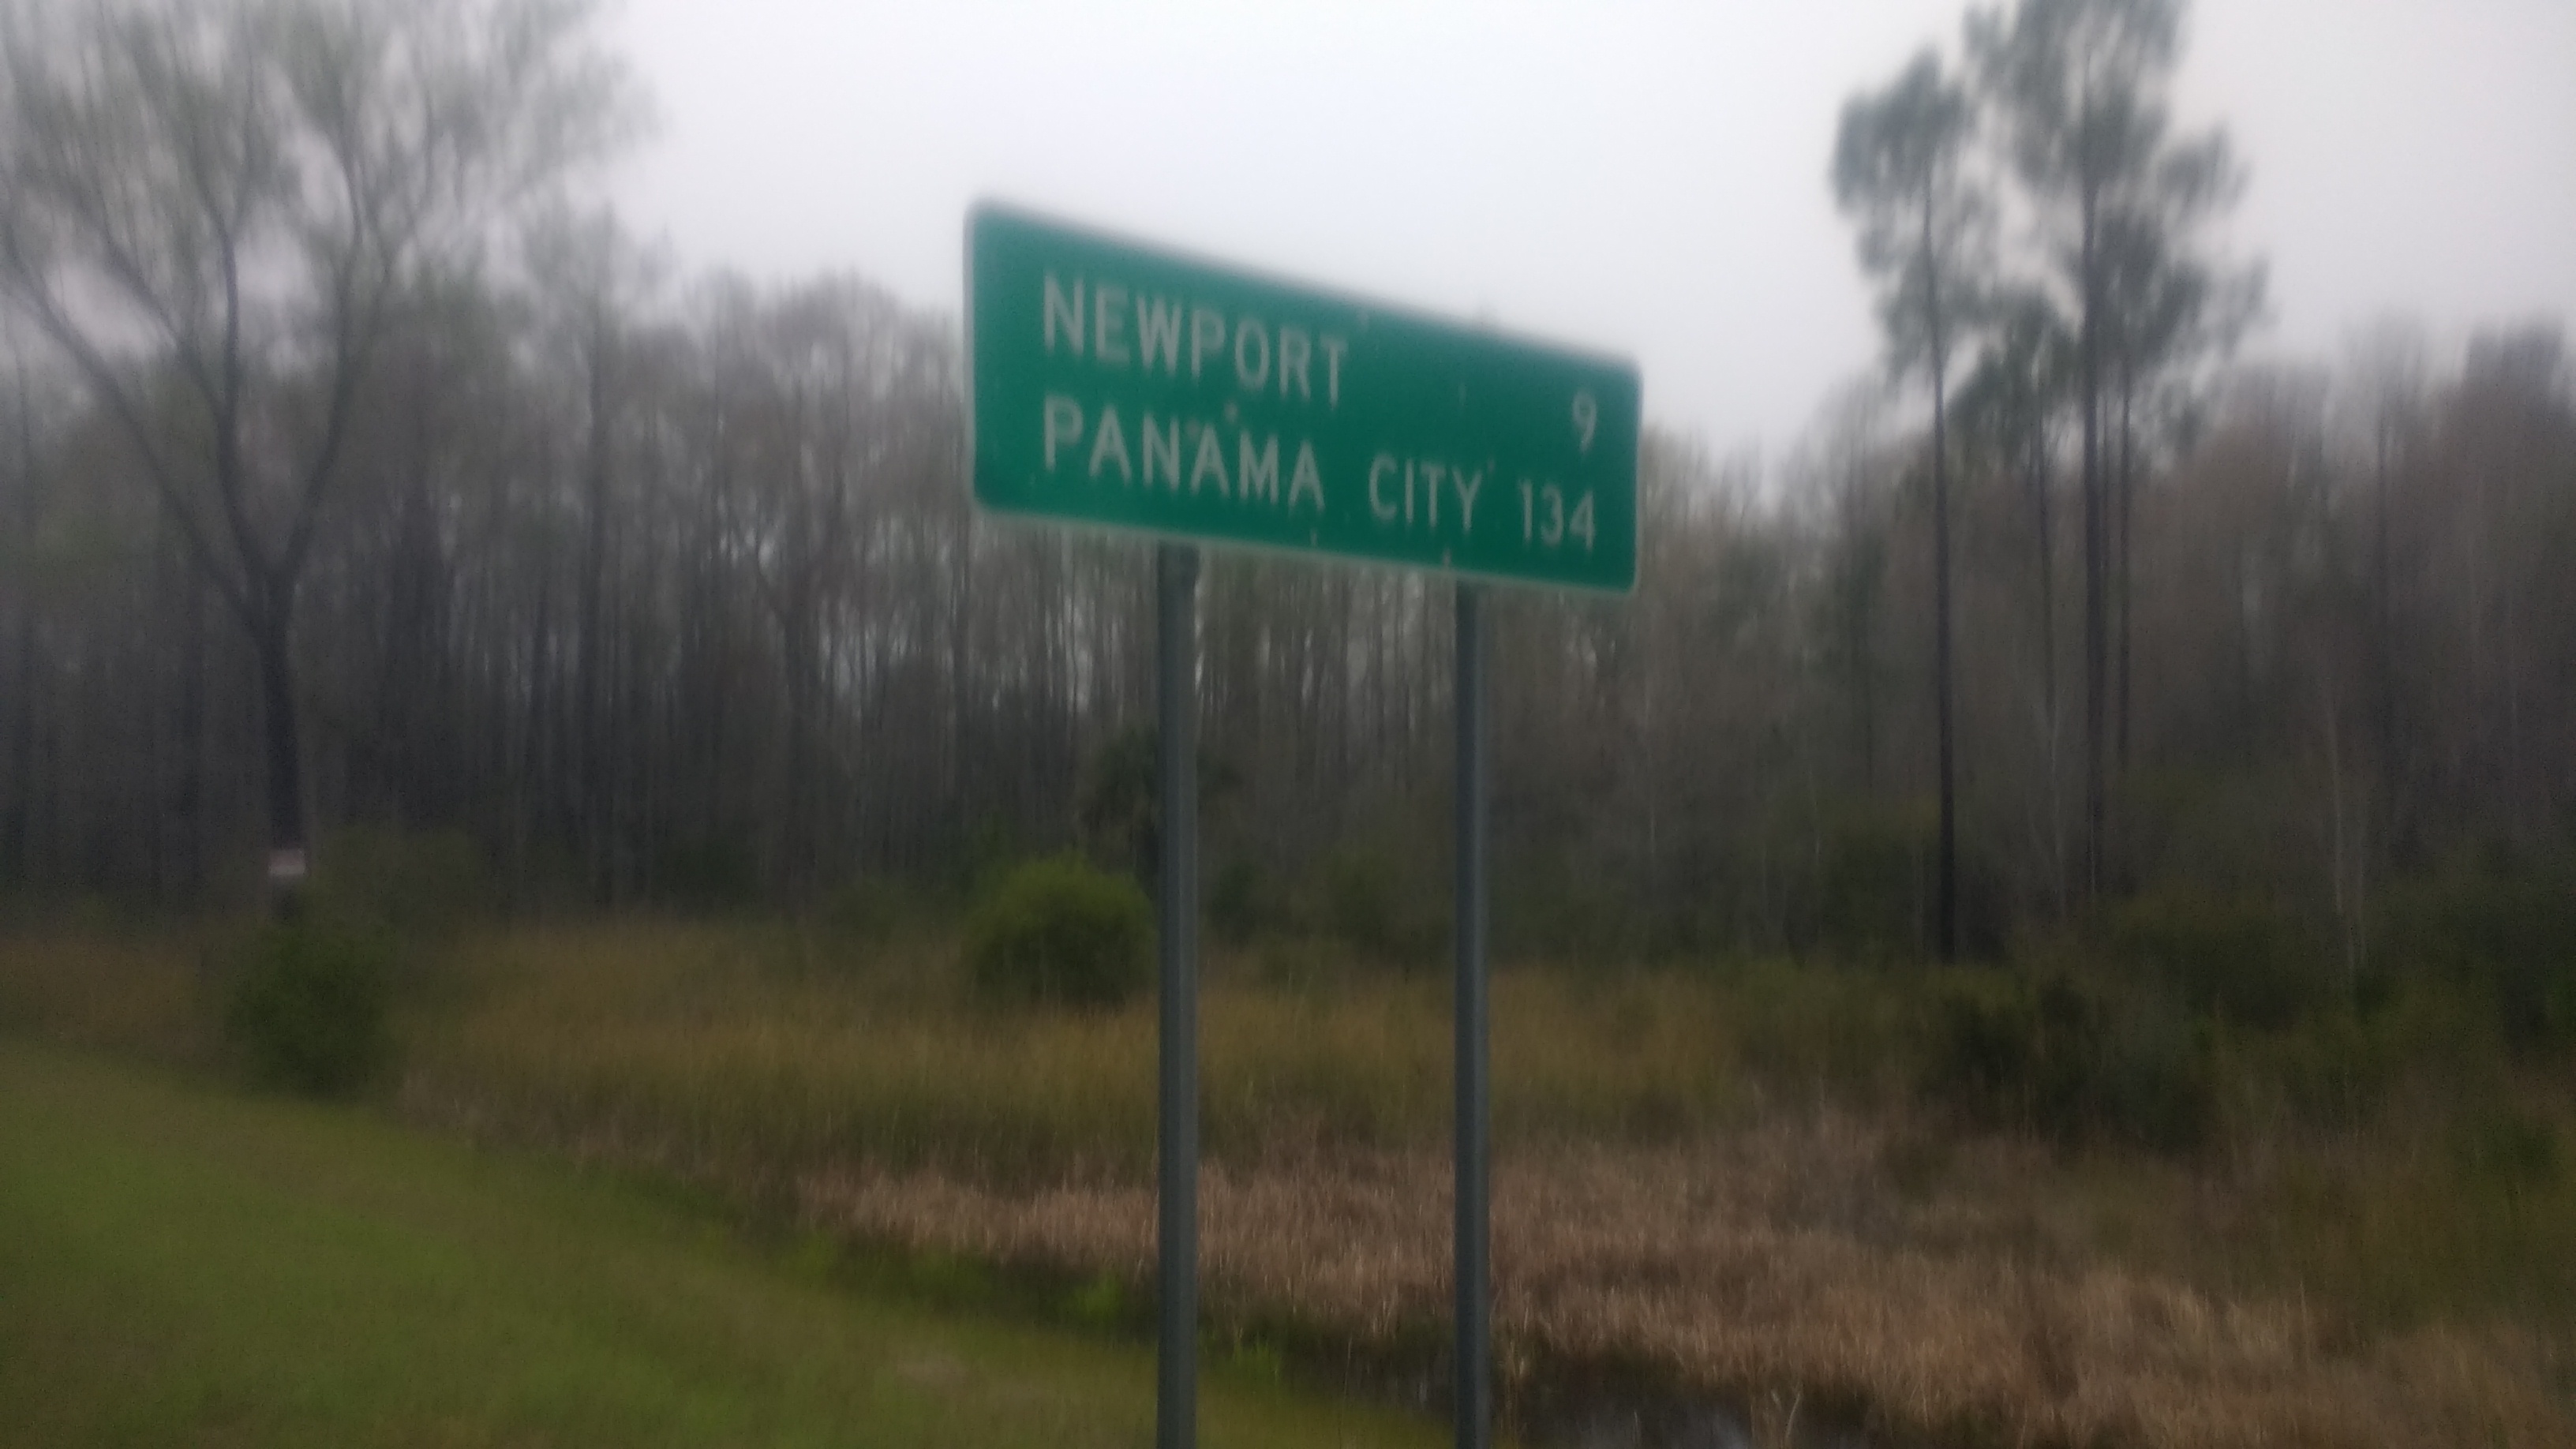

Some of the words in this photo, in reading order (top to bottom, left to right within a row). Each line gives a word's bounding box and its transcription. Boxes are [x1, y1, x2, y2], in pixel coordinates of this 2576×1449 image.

[1043, 271, 1348, 409] NEWPORT
[1571, 390, 1597, 454] 9
[1043, 394, 1326, 516] PANAMA
[1368, 451, 1485, 534] CITY
[1518, 477, 1596, 551] 134
